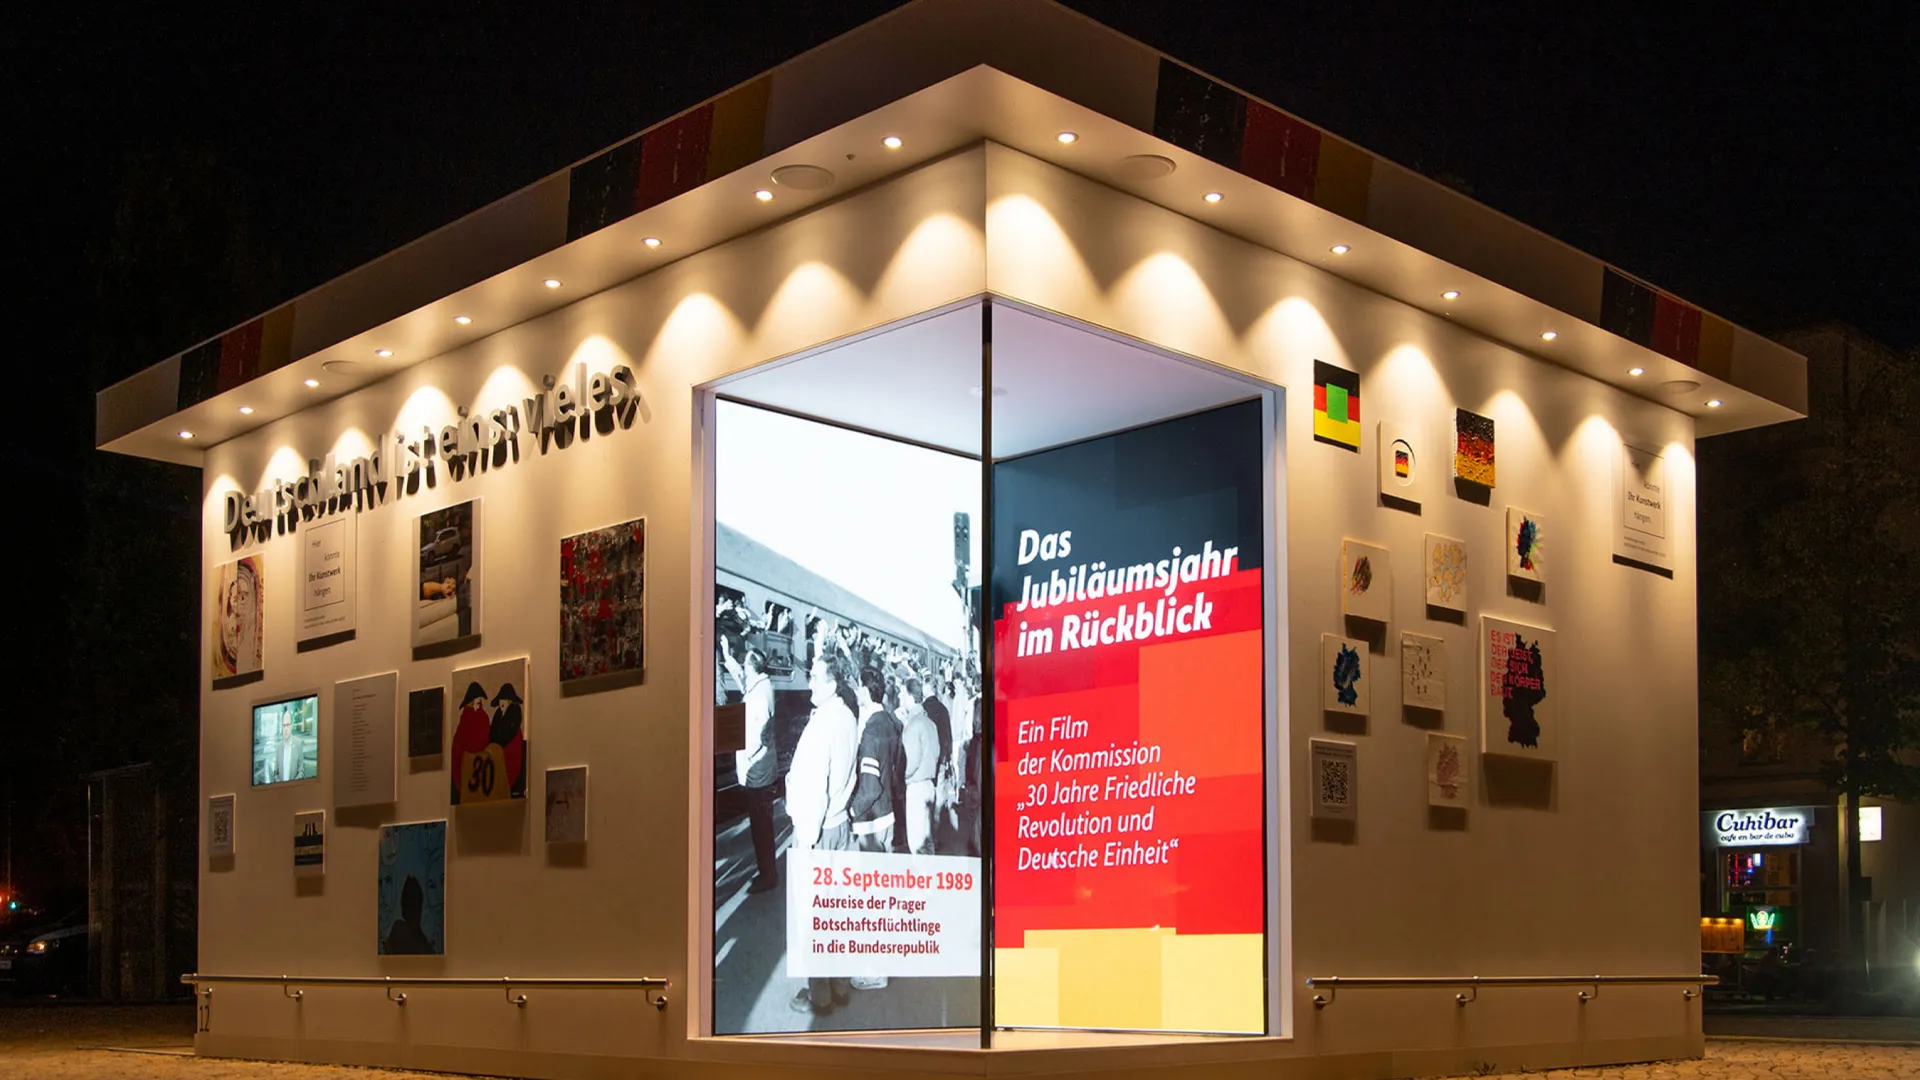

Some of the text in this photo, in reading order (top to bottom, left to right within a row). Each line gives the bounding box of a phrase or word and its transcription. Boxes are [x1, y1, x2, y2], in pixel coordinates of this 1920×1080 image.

[224, 434, 387, 534] Deutschland
[395, 425, 436, 477] ist
[1017, 529, 1072, 565] Das
[316, 566, 341, 580] Kunstwerk
[1016, 540, 1239, 612] Jubiläumsjahr
[1017, 592, 1213, 657] im Rückblick
[1490, 629, 1515, 645] ES IST
[1491, 643, 1507, 656] DER
[1017, 715, 1088, 744] Ein Film
[1017, 741, 1161, 776] der Kommission
[468, 755, 495, 797] 30
[1016, 770, 1197, 811] „30 Jahre Friedliche
[1017, 805, 1155, 839] Revolution und
[1716, 812, 1799, 832] Cuhibar
[1720, 834, 1736, 842] cafe
[1775, 831, 1794, 839] cuba
[1017, 843, 1099, 870] Deutsche
[813, 867, 973, 892] 28. September 1989
[812, 894, 926, 914] Ausreise der Prager
[812, 917, 941, 936] Botschaftsflüchtlinge
[812, 939, 940, 957] in die Bundesrepublik
